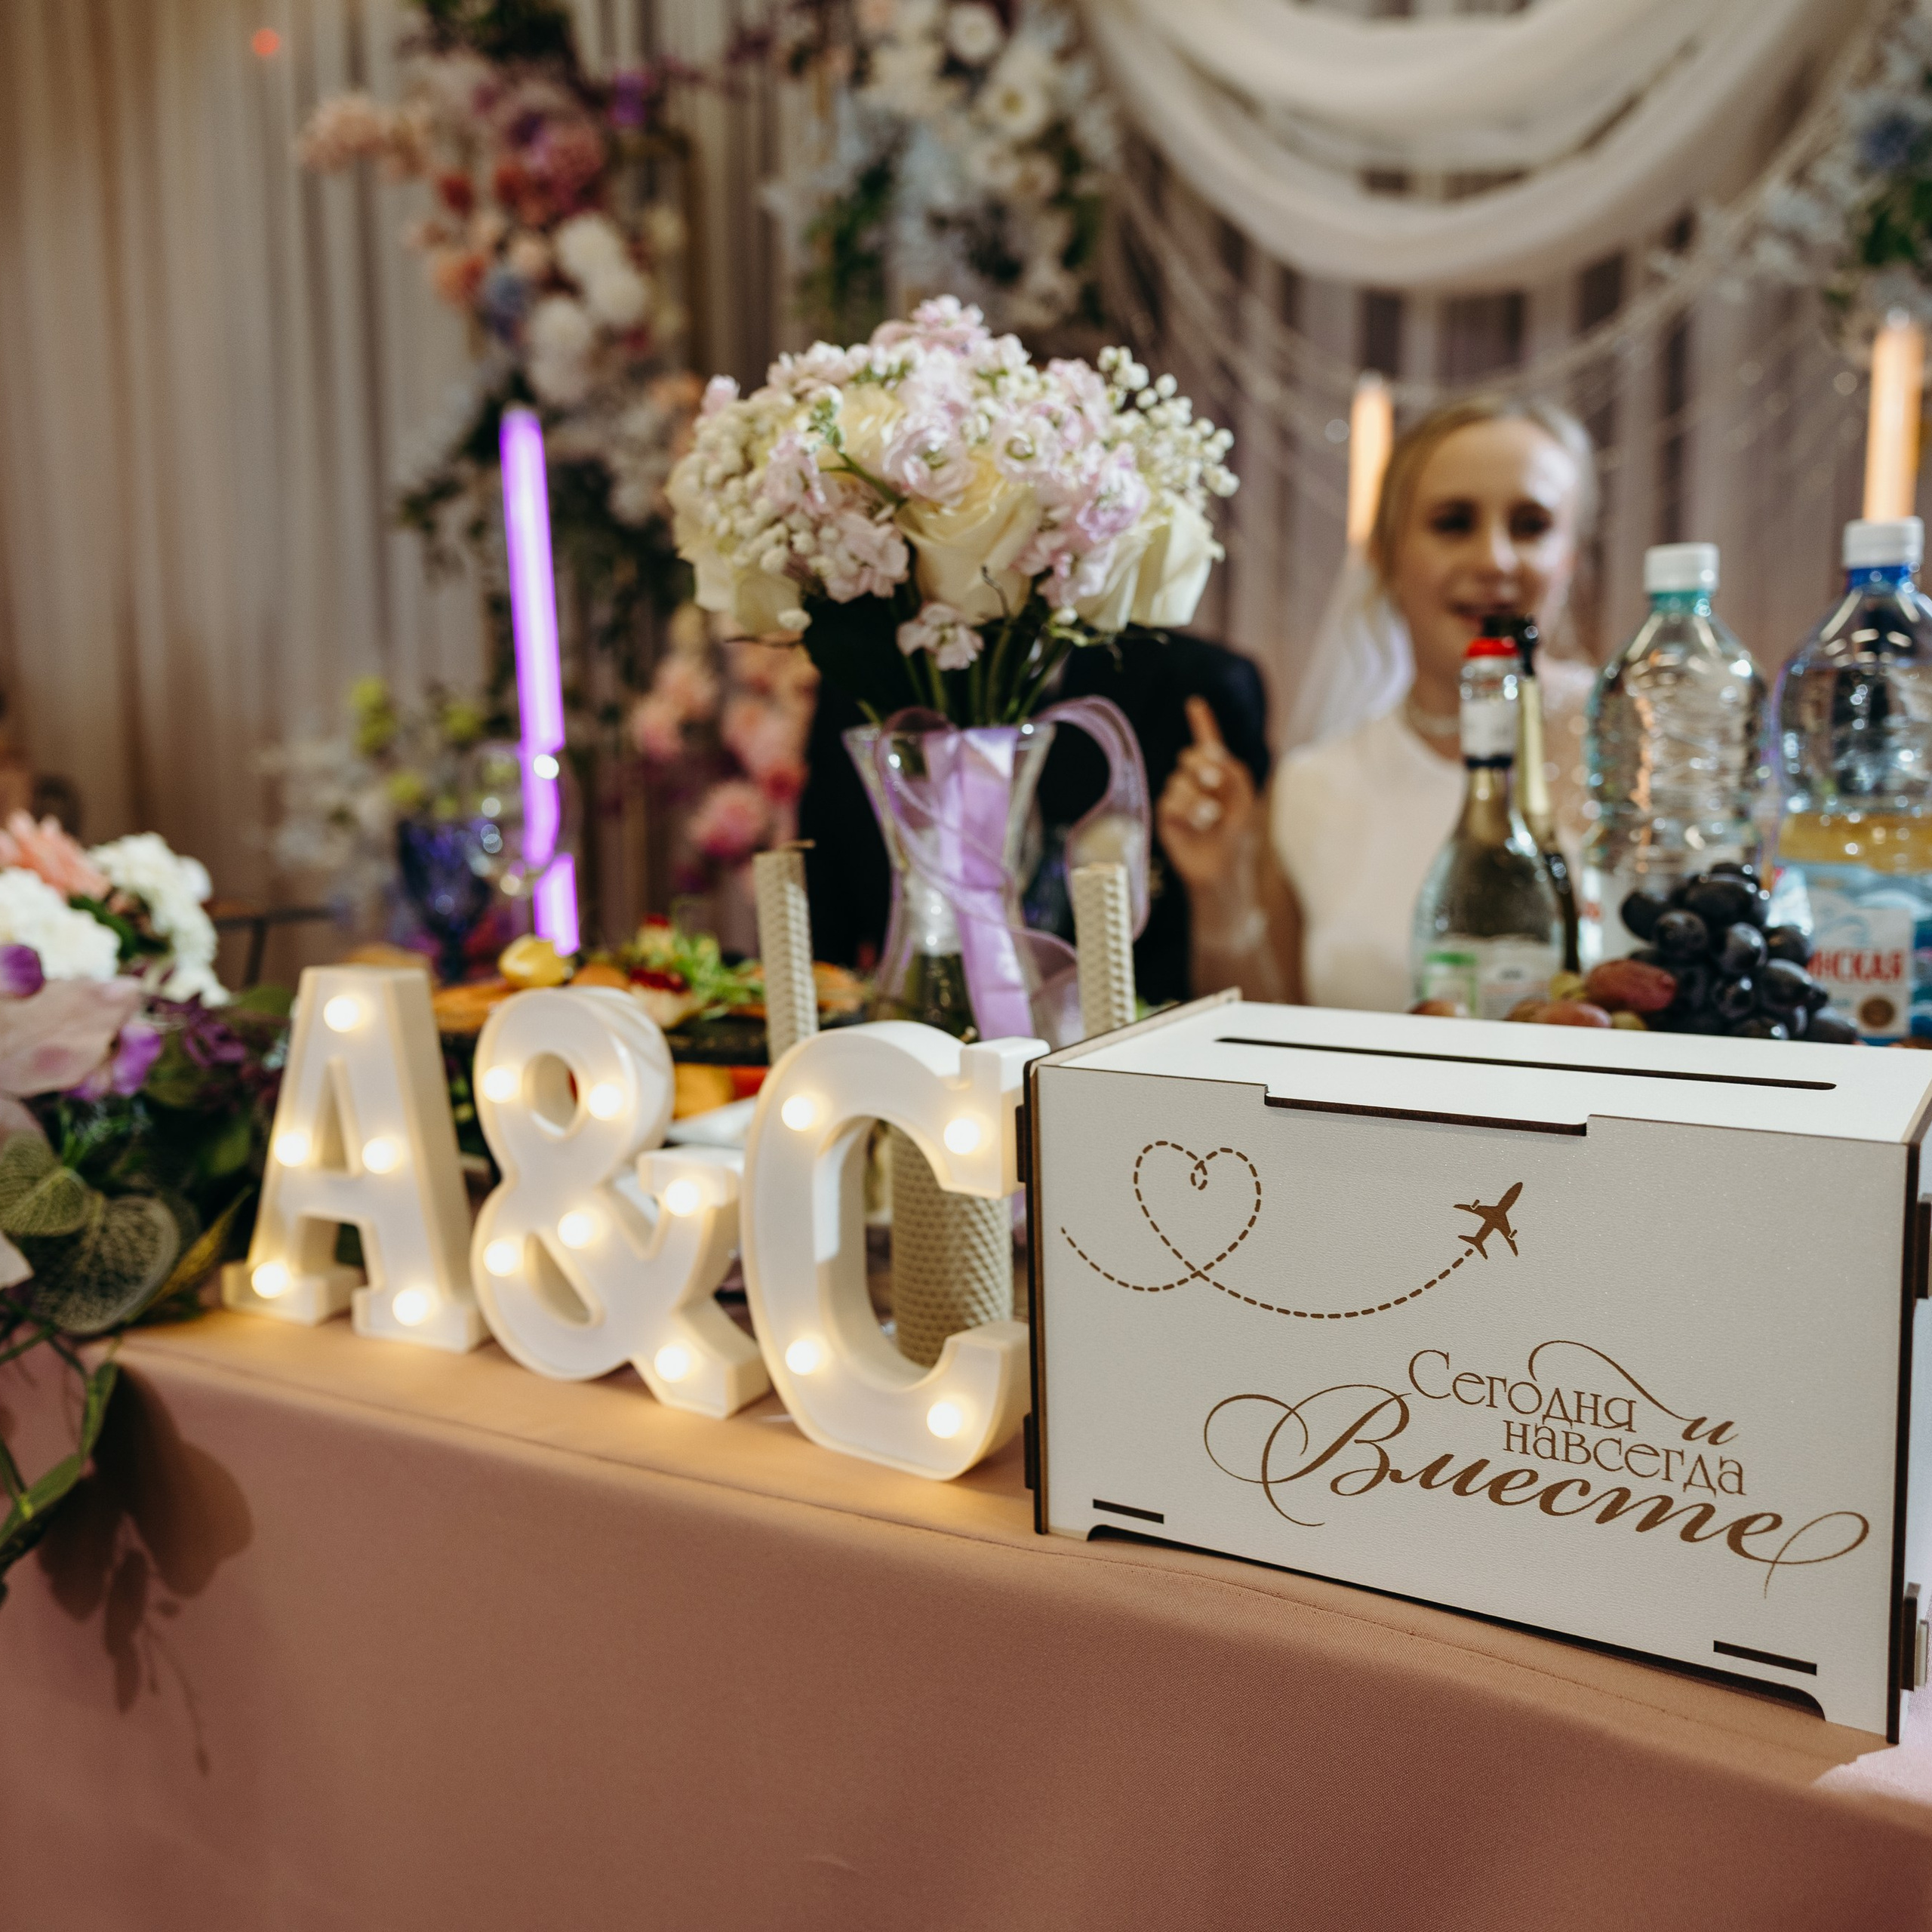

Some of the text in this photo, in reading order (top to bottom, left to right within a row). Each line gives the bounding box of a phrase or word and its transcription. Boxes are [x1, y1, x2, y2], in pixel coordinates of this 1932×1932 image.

[1408, 1349, 1637, 1433] Сегодня
[1204, 1383, 1870, 1599] Вместе
[1502, 1419, 1747, 1498] навсегда
